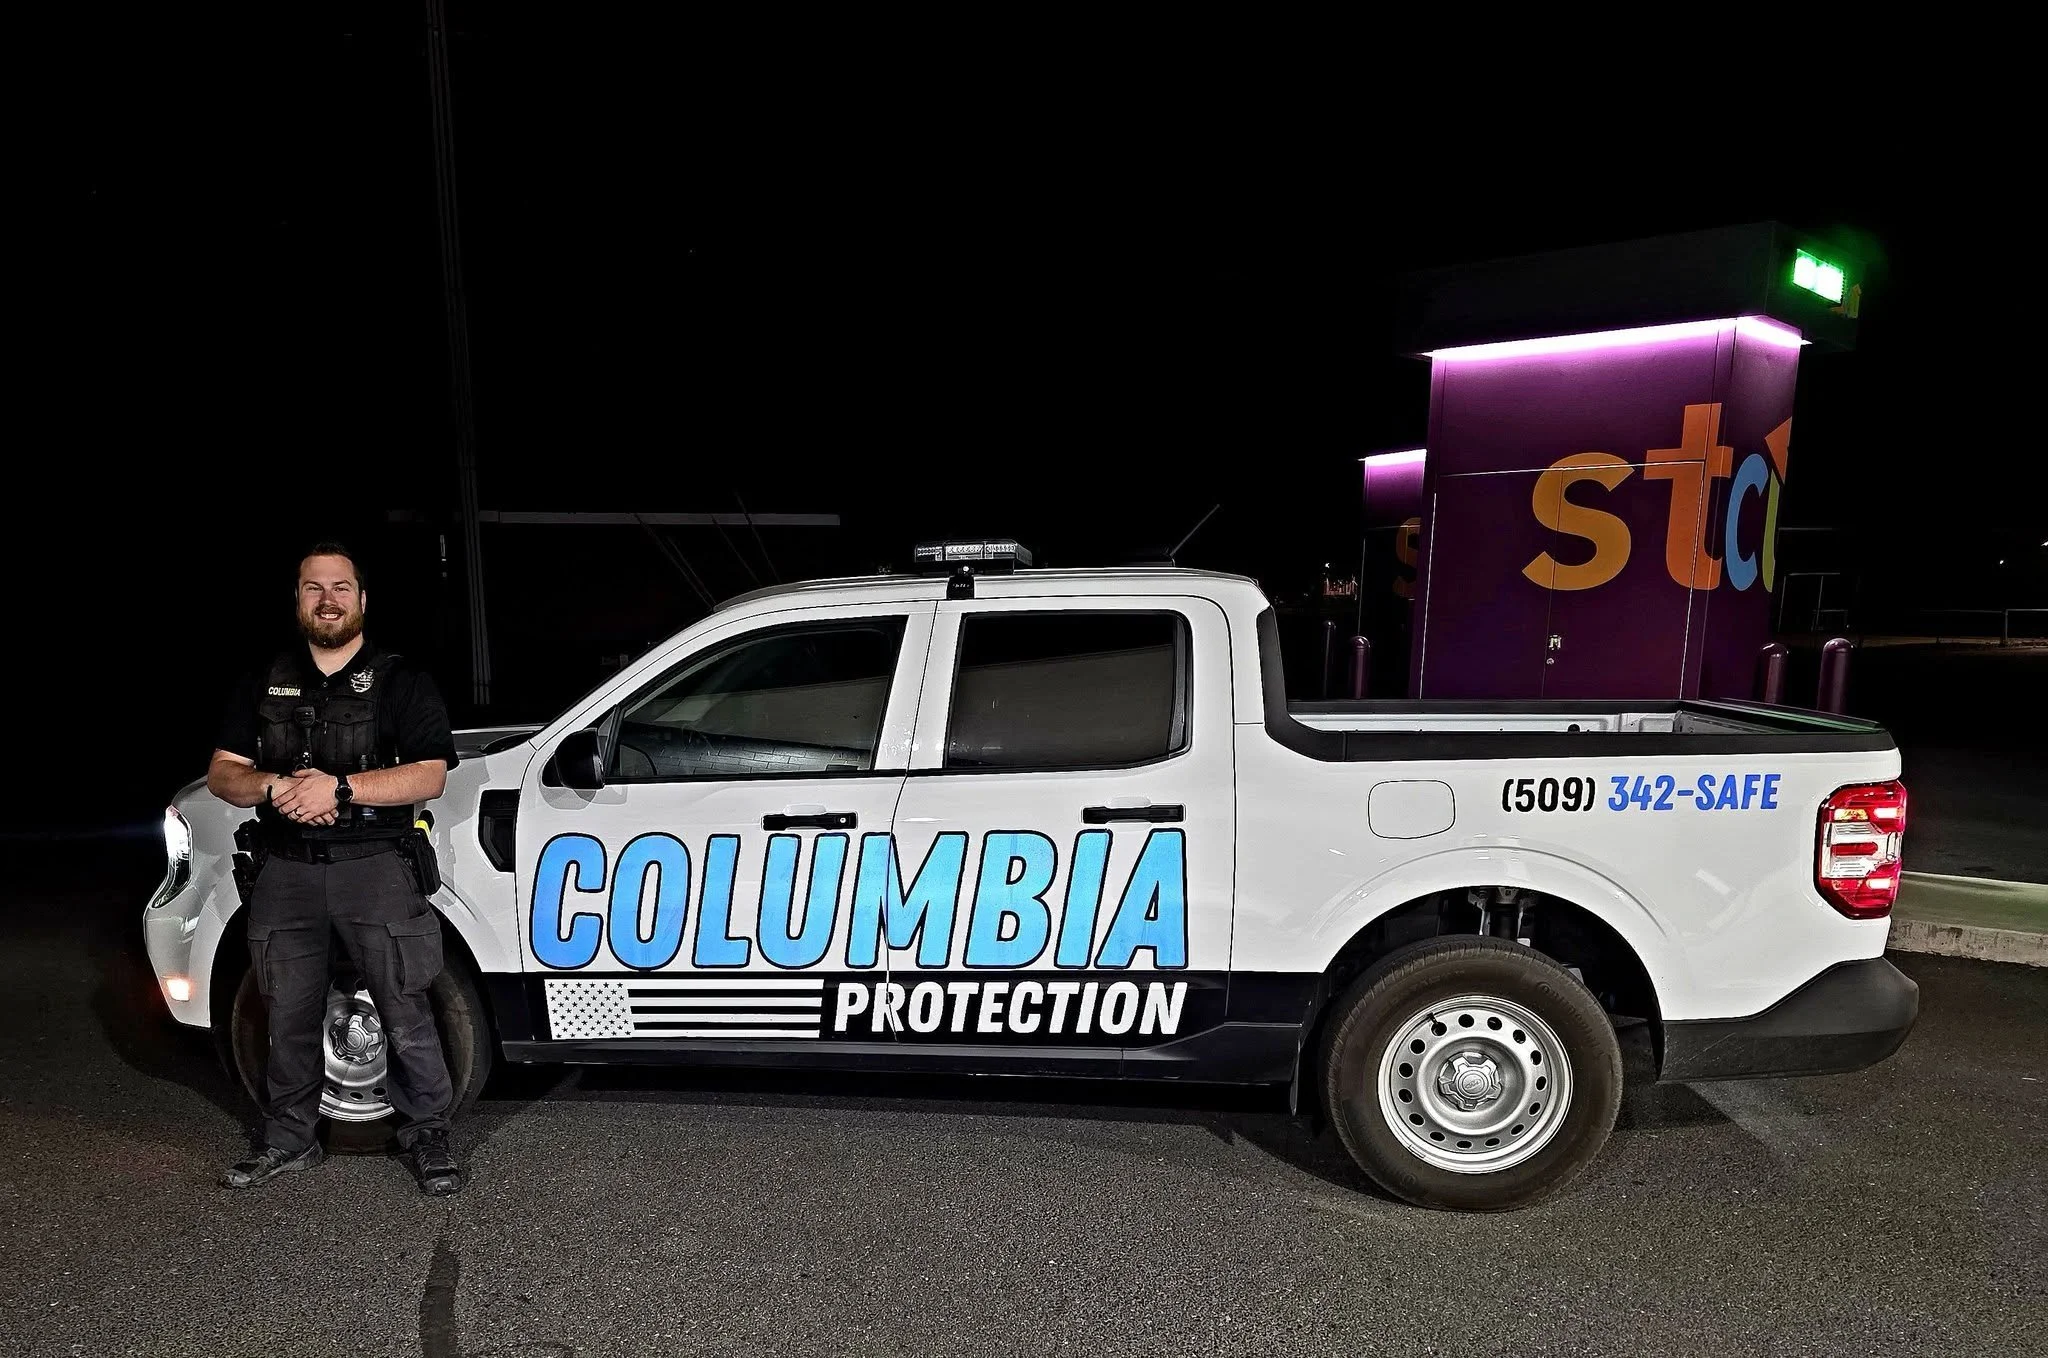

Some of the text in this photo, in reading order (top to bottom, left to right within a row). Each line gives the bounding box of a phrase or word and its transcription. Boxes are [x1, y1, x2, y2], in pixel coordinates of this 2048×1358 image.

[268, 686, 301, 697] COLUMBIA
[1502, 773, 1781, 812] (509) 342-SAFE
[529, 830, 1189, 970] COLUMBIA
[835, 981, 1187, 1035] PROTECTION
